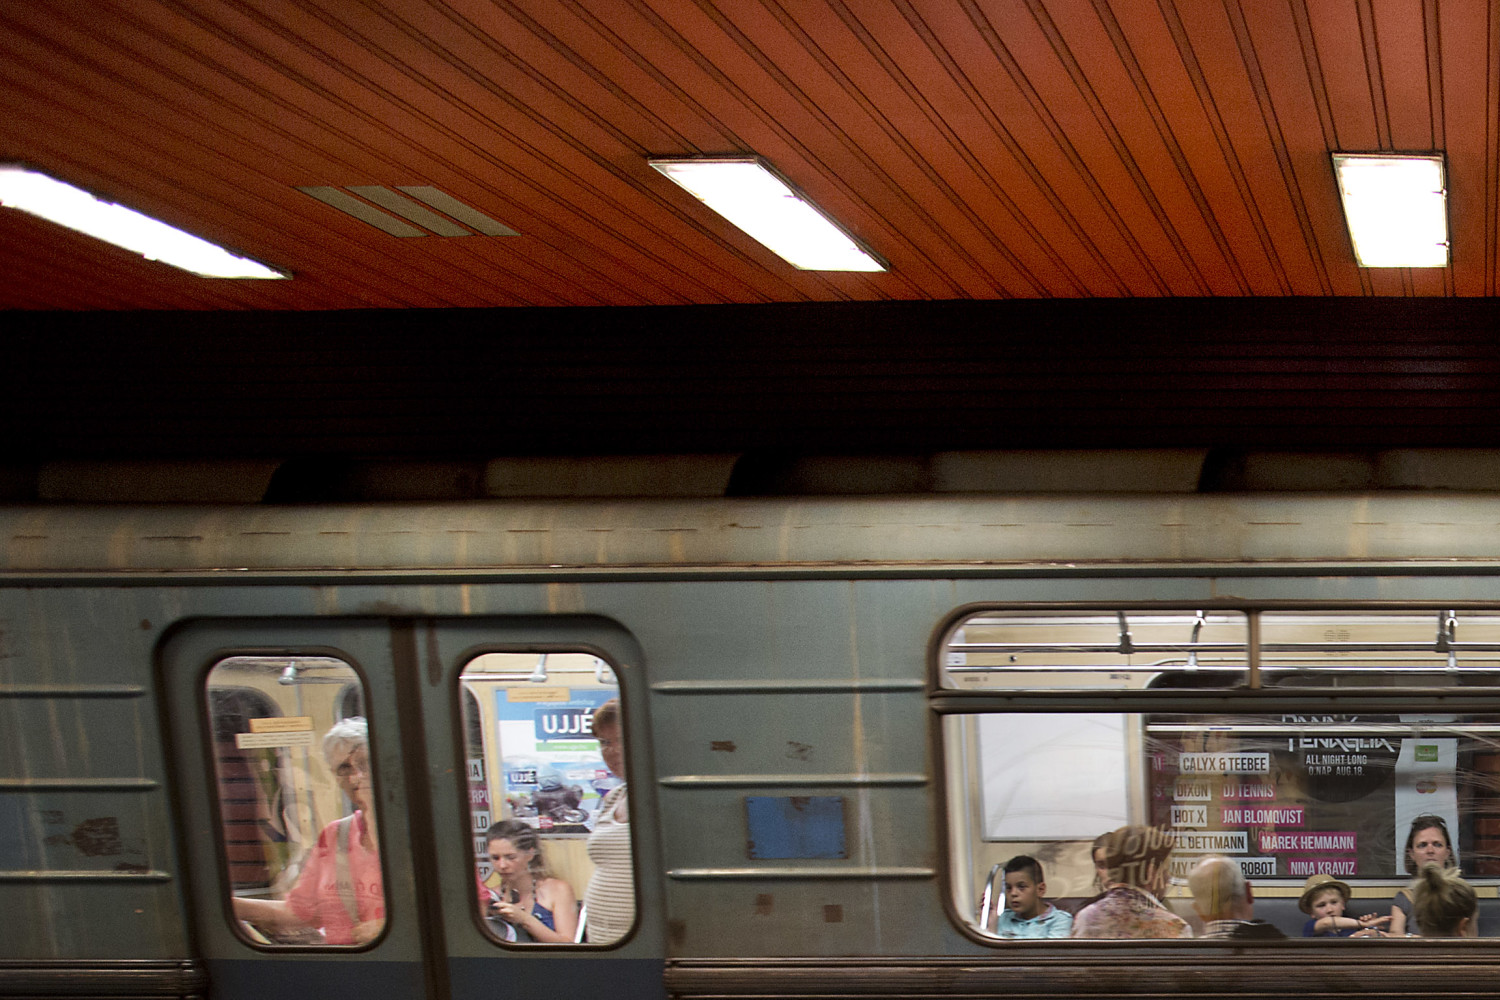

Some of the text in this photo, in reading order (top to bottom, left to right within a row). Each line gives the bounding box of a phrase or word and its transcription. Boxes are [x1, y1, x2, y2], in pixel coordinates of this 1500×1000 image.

[542, 707, 594, 734] UJJÉ
[1183, 757, 1266, 771] CALYX & TEEBEE
[1306, 755, 1367, 765] ALL NIGHT LONG
[1176, 784, 1208, 797] DIXON
[1223, 784, 1273, 798] DJ TENNIS
[1174, 809, 1205, 823] HOT X
[1223, 809, 1302, 824] JAN BLOMQVIST
[1188, 835, 1244, 849] DETTMANN
[1261, 836, 1354, 850] MAREK HEMMANN
[1241, 862, 1274, 875] ROBOT
[1290, 862, 1355, 875] NINA KRAVIZ
